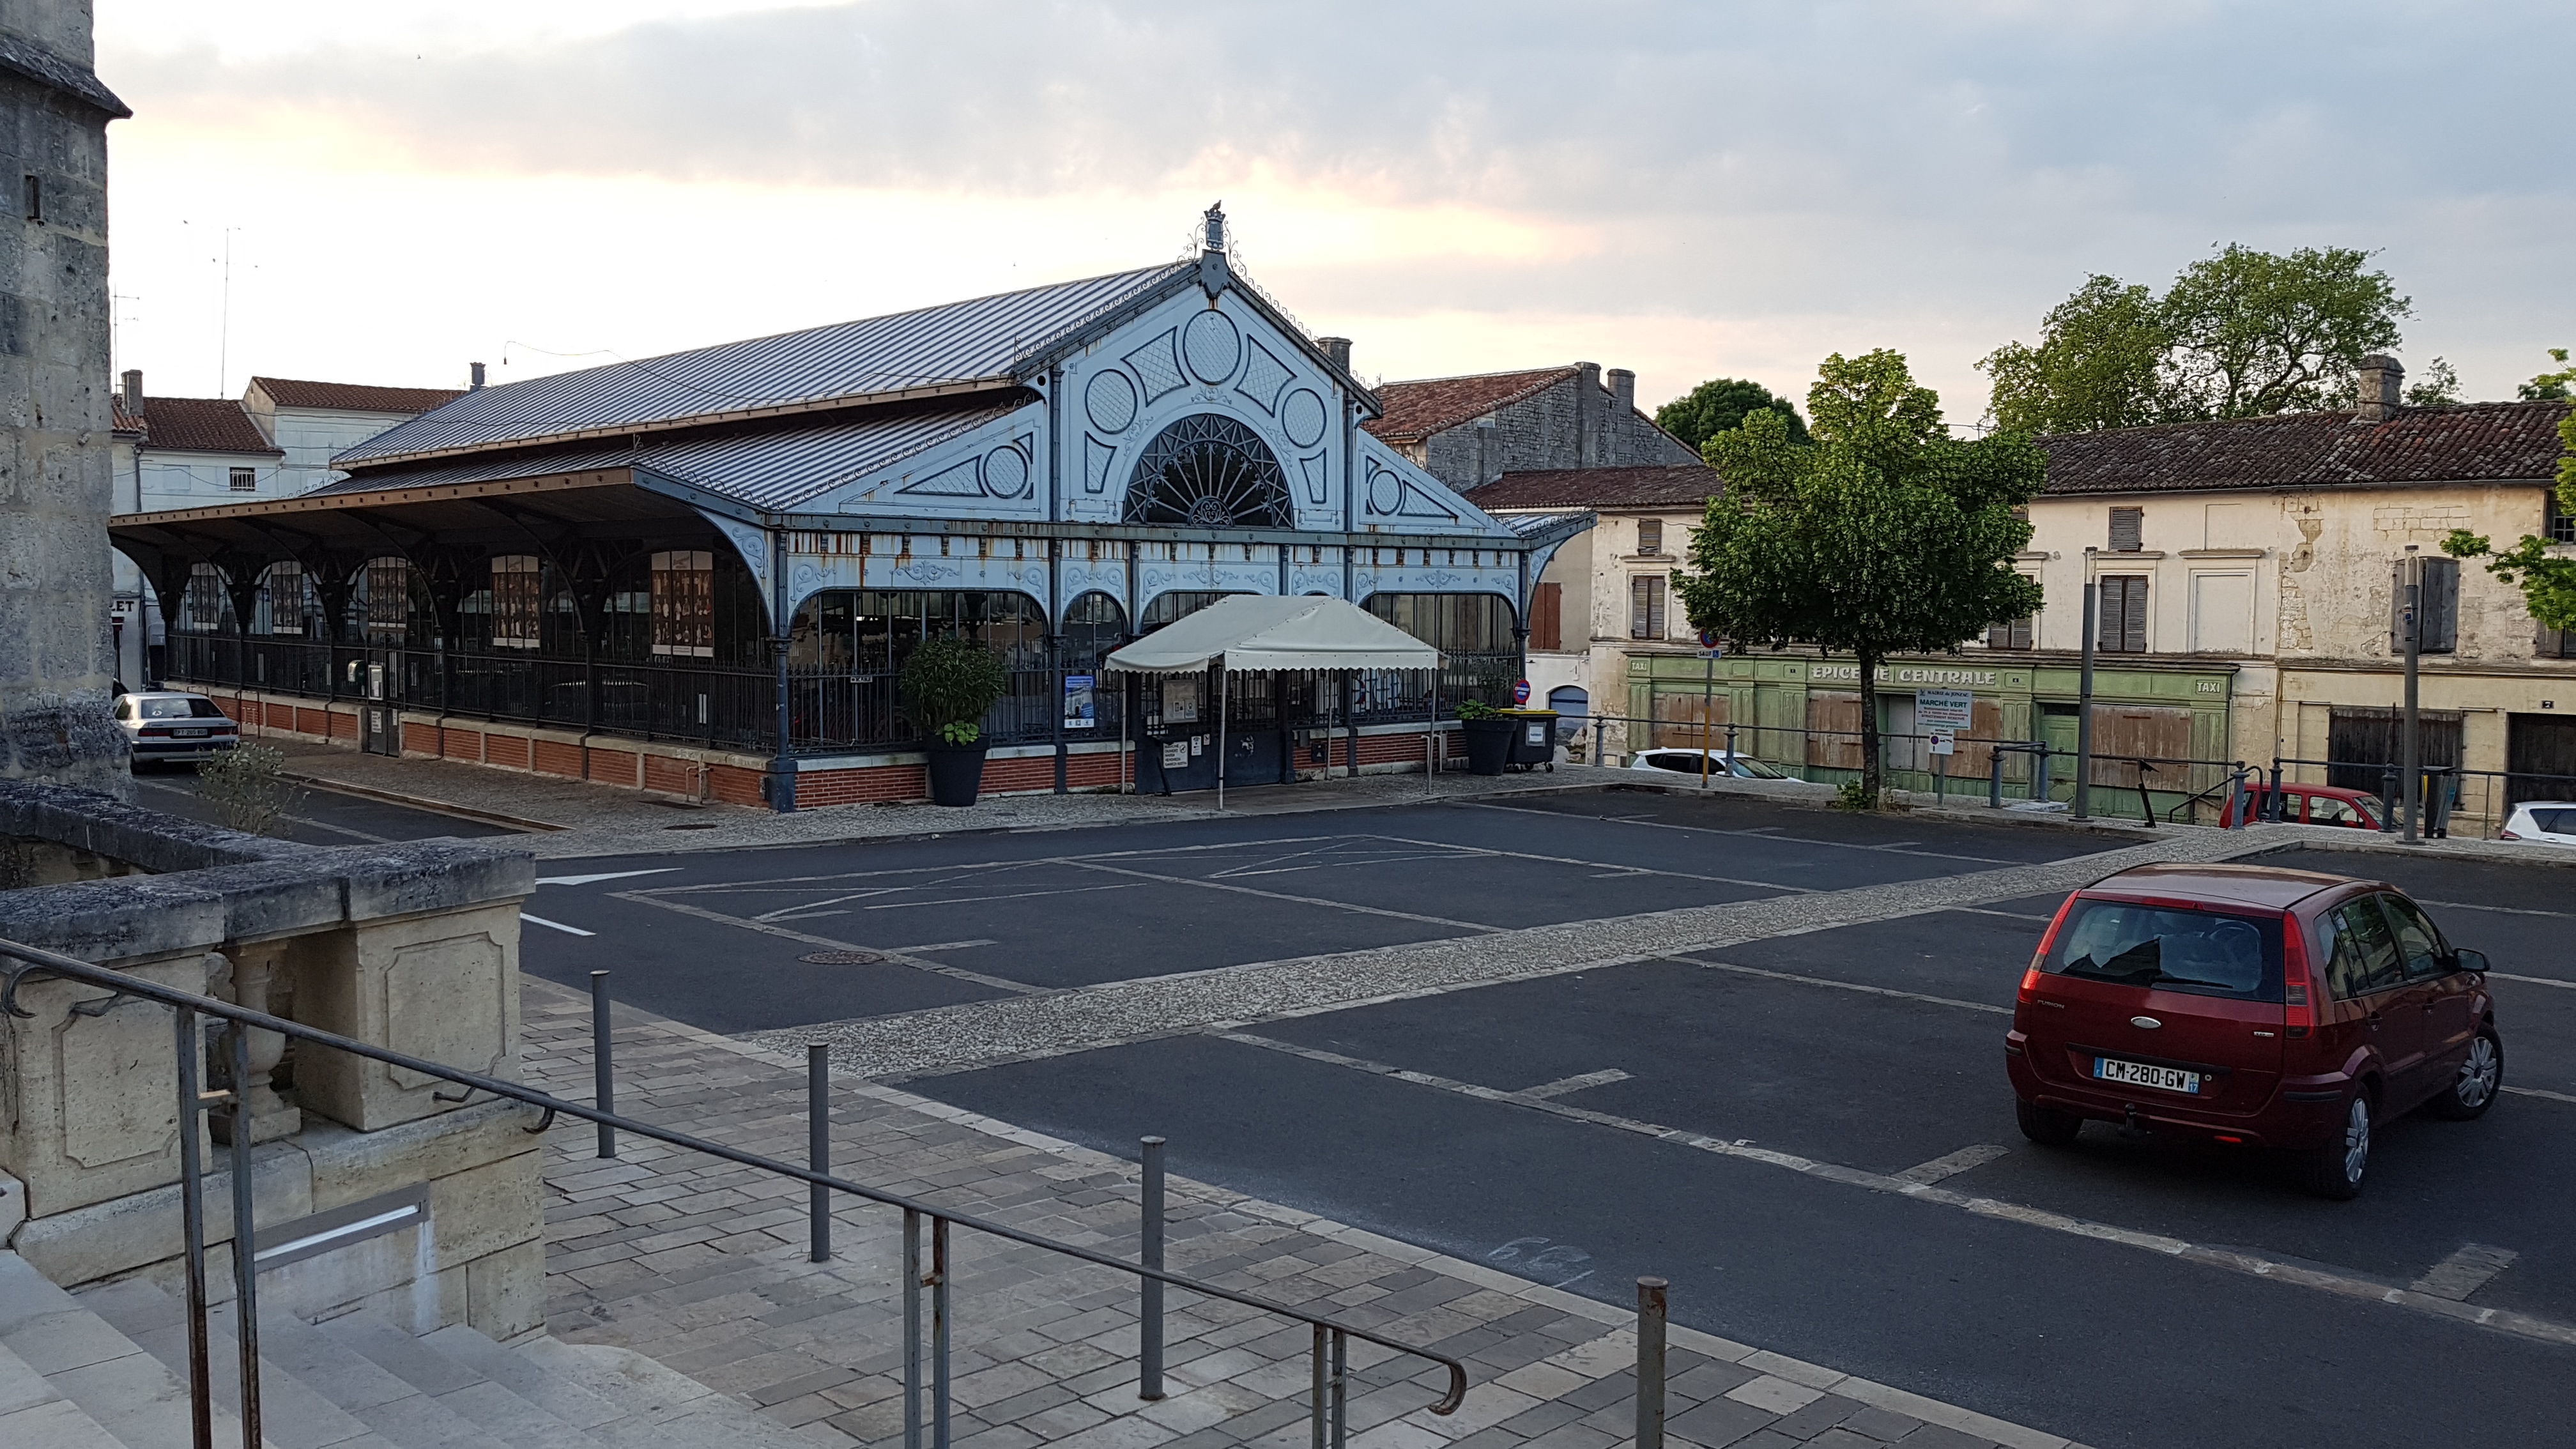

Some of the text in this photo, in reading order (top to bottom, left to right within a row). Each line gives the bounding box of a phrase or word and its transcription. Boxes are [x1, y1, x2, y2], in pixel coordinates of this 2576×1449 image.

[1631, 663, 1647, 671] TAXI
[1812, 666, 1997, 685] EPICEIE CENTRALE
[2196, 682, 2220, 693] TAXI
[2037, 999, 2065, 1009] FUSION
[2105, 1061, 2186, 1089] CM-280-GW
[2189, 1083, 2198, 1092] 17
